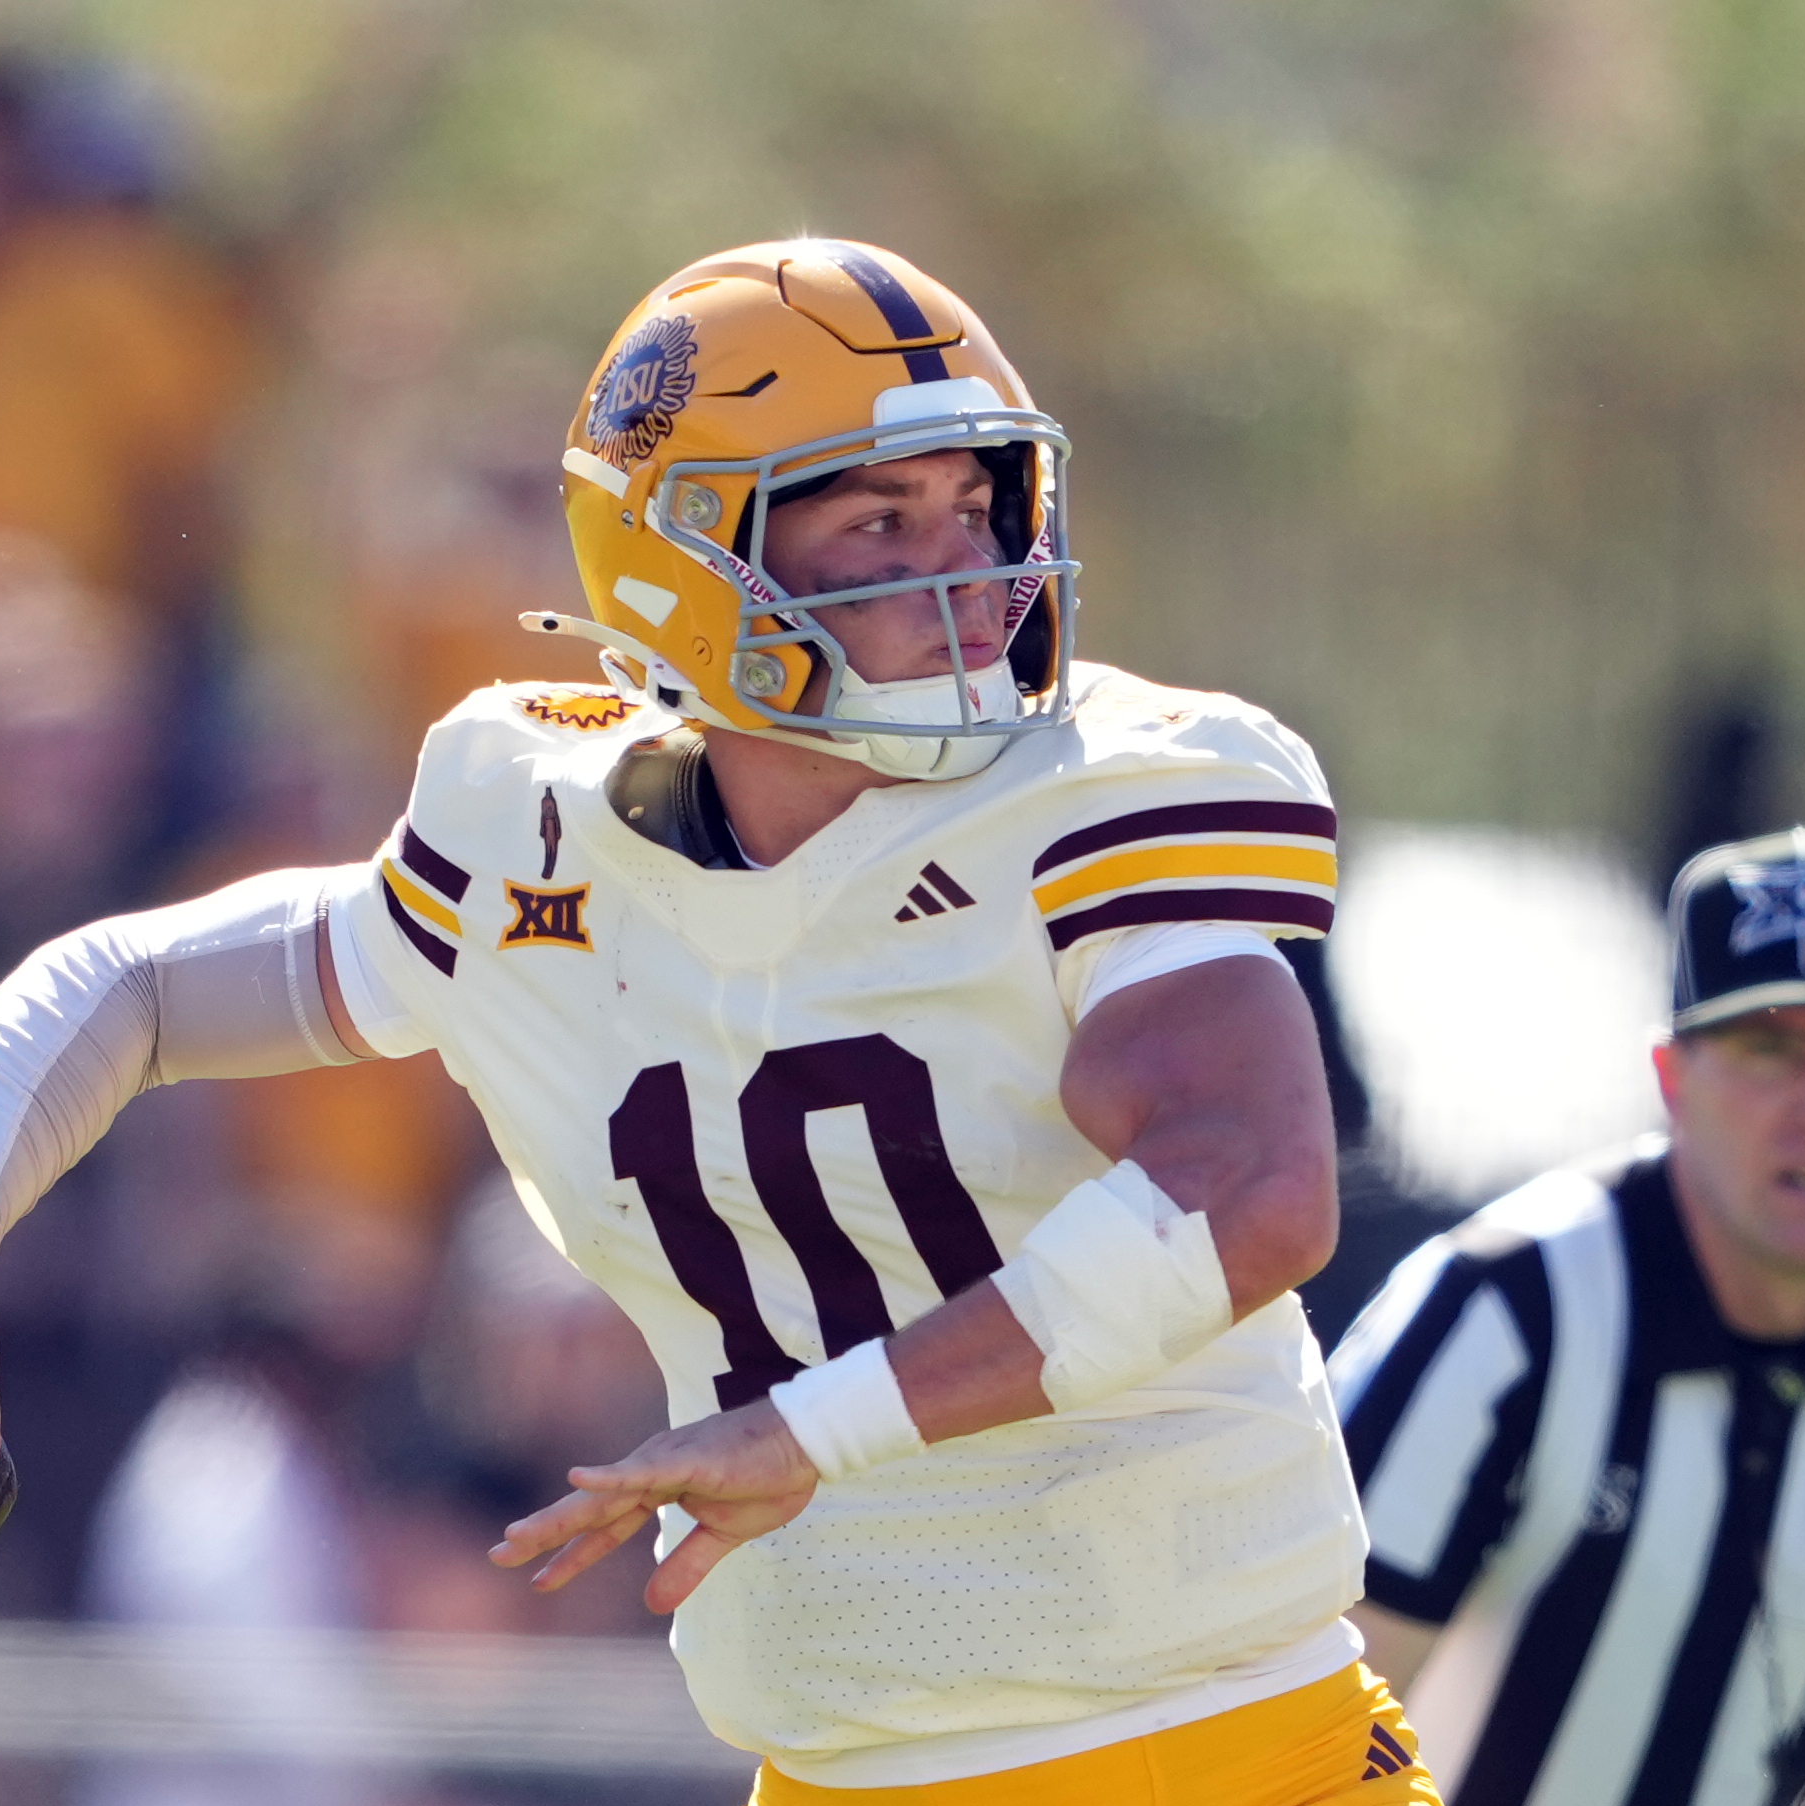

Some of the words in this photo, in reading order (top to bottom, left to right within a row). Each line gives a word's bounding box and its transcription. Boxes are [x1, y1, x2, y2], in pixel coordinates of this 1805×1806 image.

[607, 359, 664, 415] ASU
[1004, 551, 1051, 630] ARIZOA
[503, 885, 589, 946] XII
[608, 1032, 1004, 1412] 10
